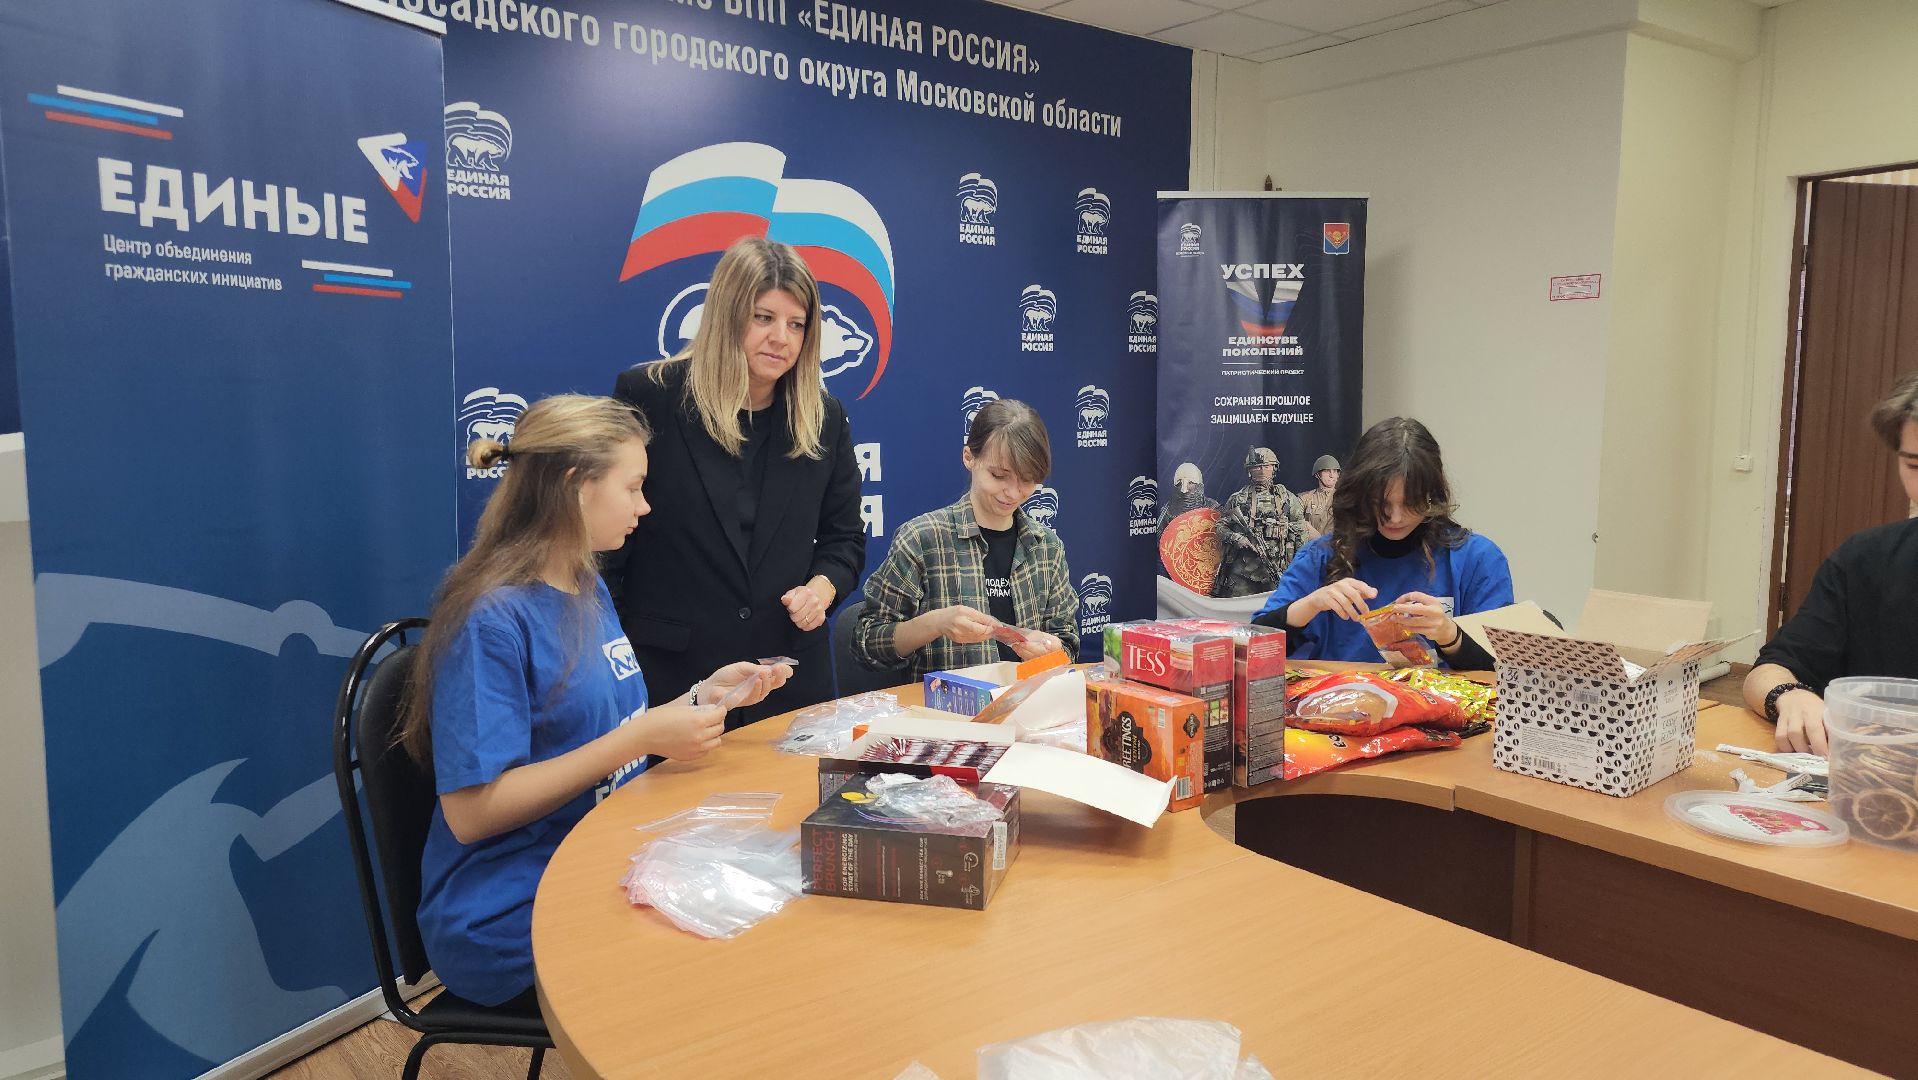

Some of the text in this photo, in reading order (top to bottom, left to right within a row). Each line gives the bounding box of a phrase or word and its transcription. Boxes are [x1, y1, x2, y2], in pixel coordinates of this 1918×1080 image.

[931, 26, 1041, 76] РОССИЯ»
[612, 21, 789, 81] городского
[799, 56, 887, 98] округа
[896, 68, 1036, 124] Московской
[1042, 99, 1123, 138] области
[447, 168, 510, 187] ЕДИНАЯ
[447, 182, 511, 201] РОССИЯ
[97, 156, 369, 245] ЕДИНЫЕ
[959, 223, 995, 235] ЕДИНАЯ
[959, 233, 996, 246] РОССИЯ
[1076, 234, 1108, 245] ЕДИНАЯ
[103, 234, 253, 266] Центр объединения
[1076, 244, 1108, 255] РОССИЯ
[104, 263, 283, 292] гражданских инициатив
[1220, 263, 1305, 280] УСПЕХ
[1021, 332, 1054, 342] ЕДИНАЯ
[1128, 335, 1157, 344] ЕДИНАЯ
[1228, 336, 1299, 346] ЕДИНСТВЕ
[1021, 342, 1054, 352] РОССИЯ
[1128, 343, 1157, 353] РОССИЯ
[1222, 346, 1304, 357] ПОКОЛЕНИЙ
[1214, 395, 1312, 407] СОХРАНЯЯ ПРОШЛОЕ
[1210, 413, 1314, 425] ЗАЩИЩАЕМ БУДУЩЕЕ
[1077, 430, 1108, 440] ЕДИНАЯ
[1077, 438, 1108, 448] РОССИЯ
[466, 466, 509, 480] РОСС
[1129, 517, 1157, 528] ЕДИНАЯ
[1129, 526, 1157, 537] РОССИЯ
[1081, 613, 1111, 625] ЕДИНАЯ
[1126, 644, 1166, 677] TESS
[1121, 716, 1132, 769] REETINGS
[812, 828, 823, 890] PERFECT
[825, 831, 836, 891] BRUNCH
[848, 861, 854, 872] OF
